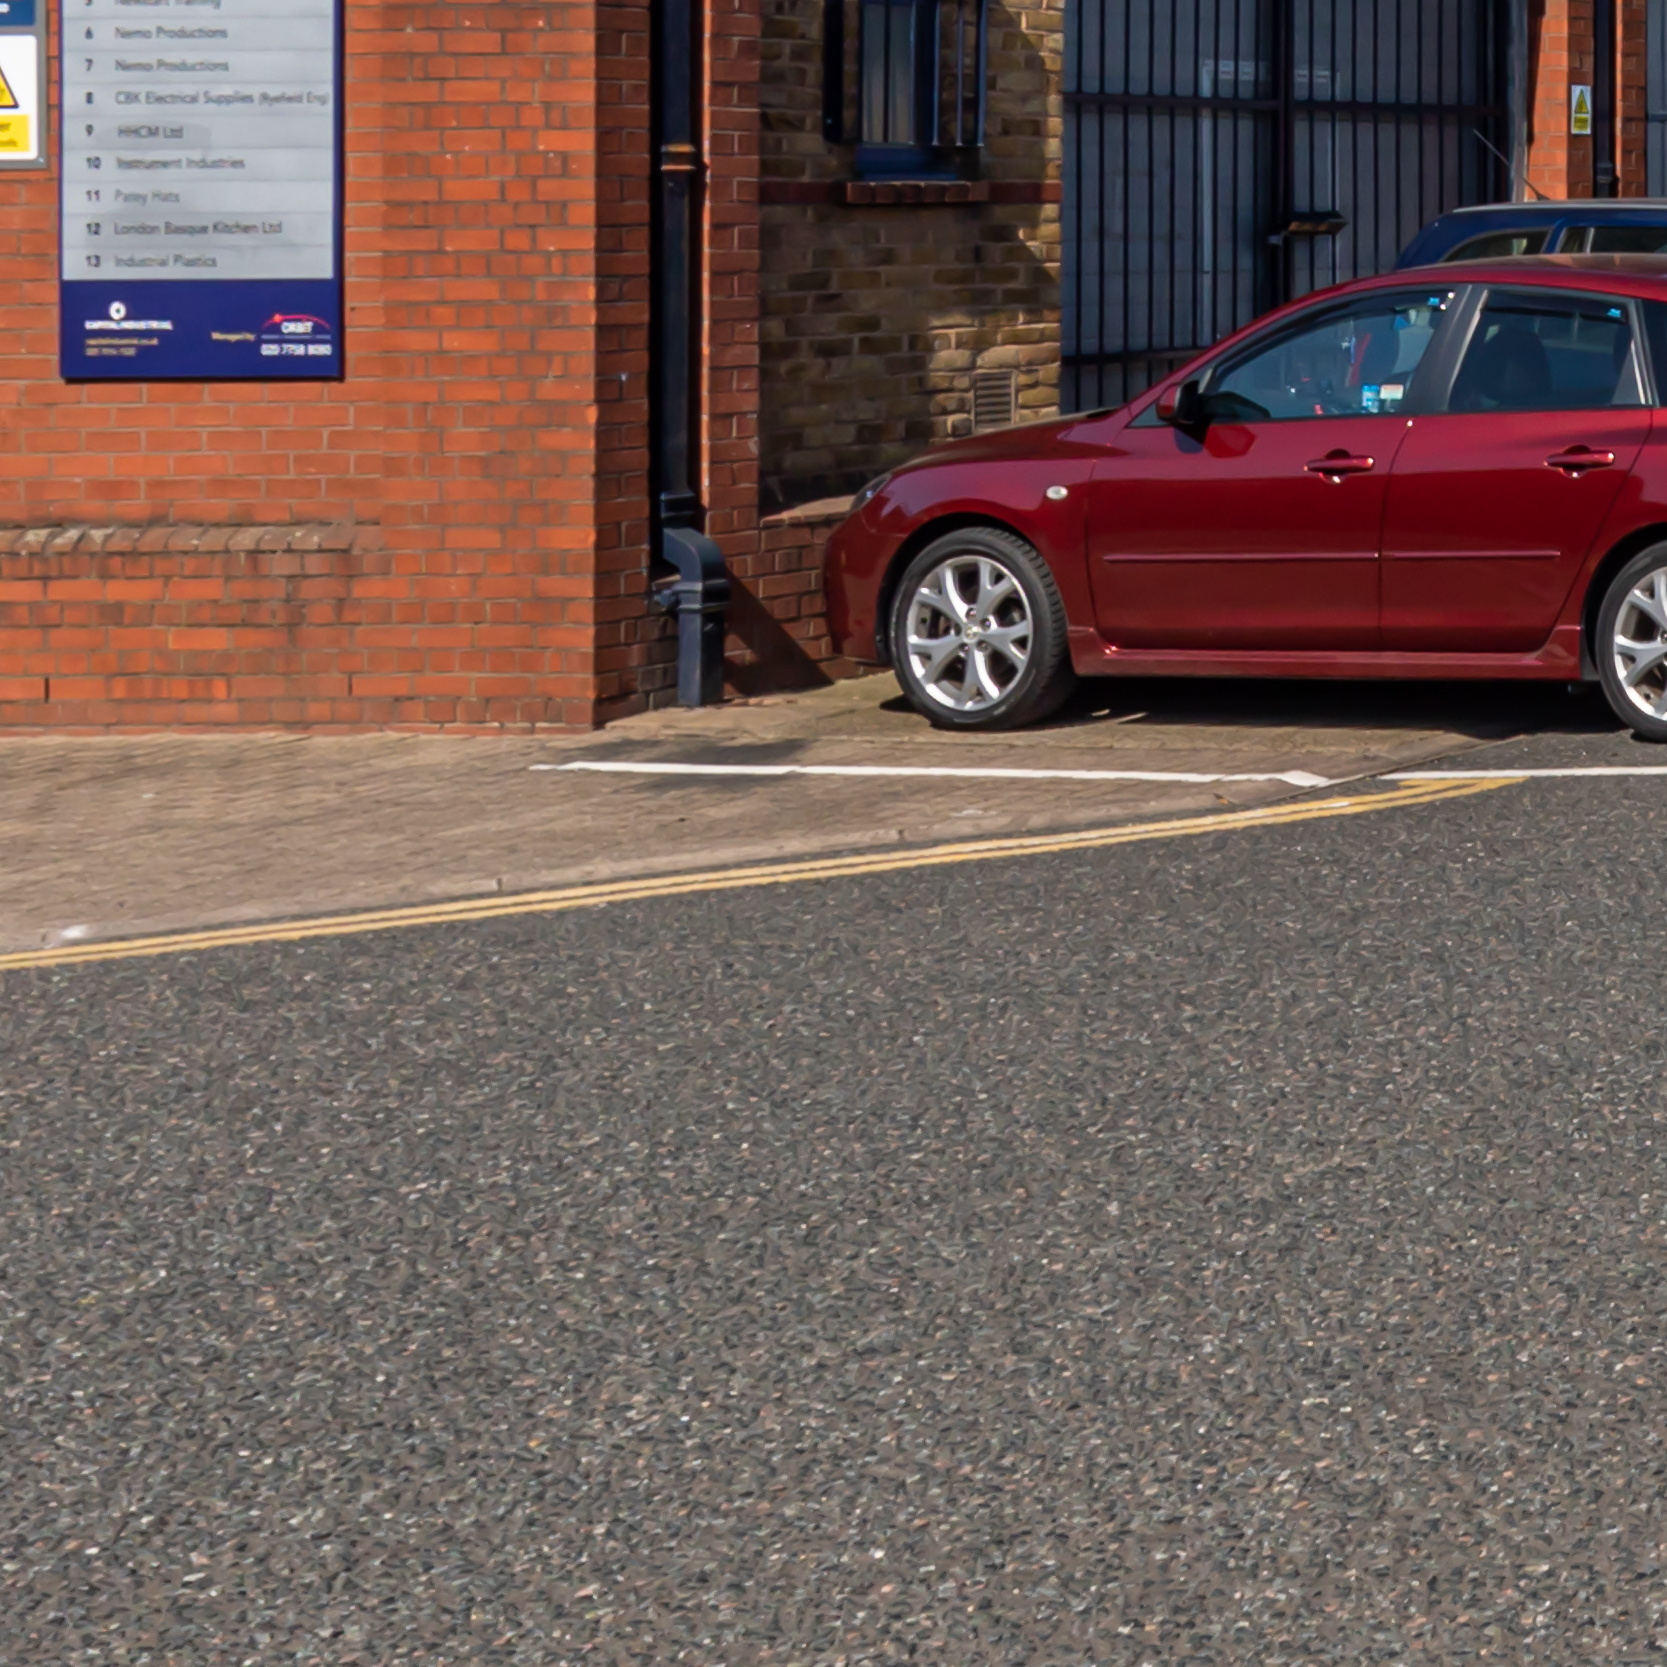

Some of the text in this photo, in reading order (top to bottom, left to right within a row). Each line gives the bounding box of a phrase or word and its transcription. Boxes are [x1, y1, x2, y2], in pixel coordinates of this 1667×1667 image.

[156, 26, 228, 39] Productions
[85, 58, 93, 71] 7
[157, 59, 229, 71] Productions
[86, 92, 93, 104] 8
[145, 91, 199, 104] Electrical
[203, 90, 254, 106] Supplies
[86, 124, 94, 136] 9
[164, 126, 184, 138] Ltd
[86, 156, 101, 169] 10
[186, 156, 245, 169] Industries
[86, 190, 100, 202] 11
[87, 222, 101, 235] 12
[114, 222, 161, 234] London
[262, 221, 282, 234] Ltd
[87, 254, 217, 268] 13 Industrial Plastics
